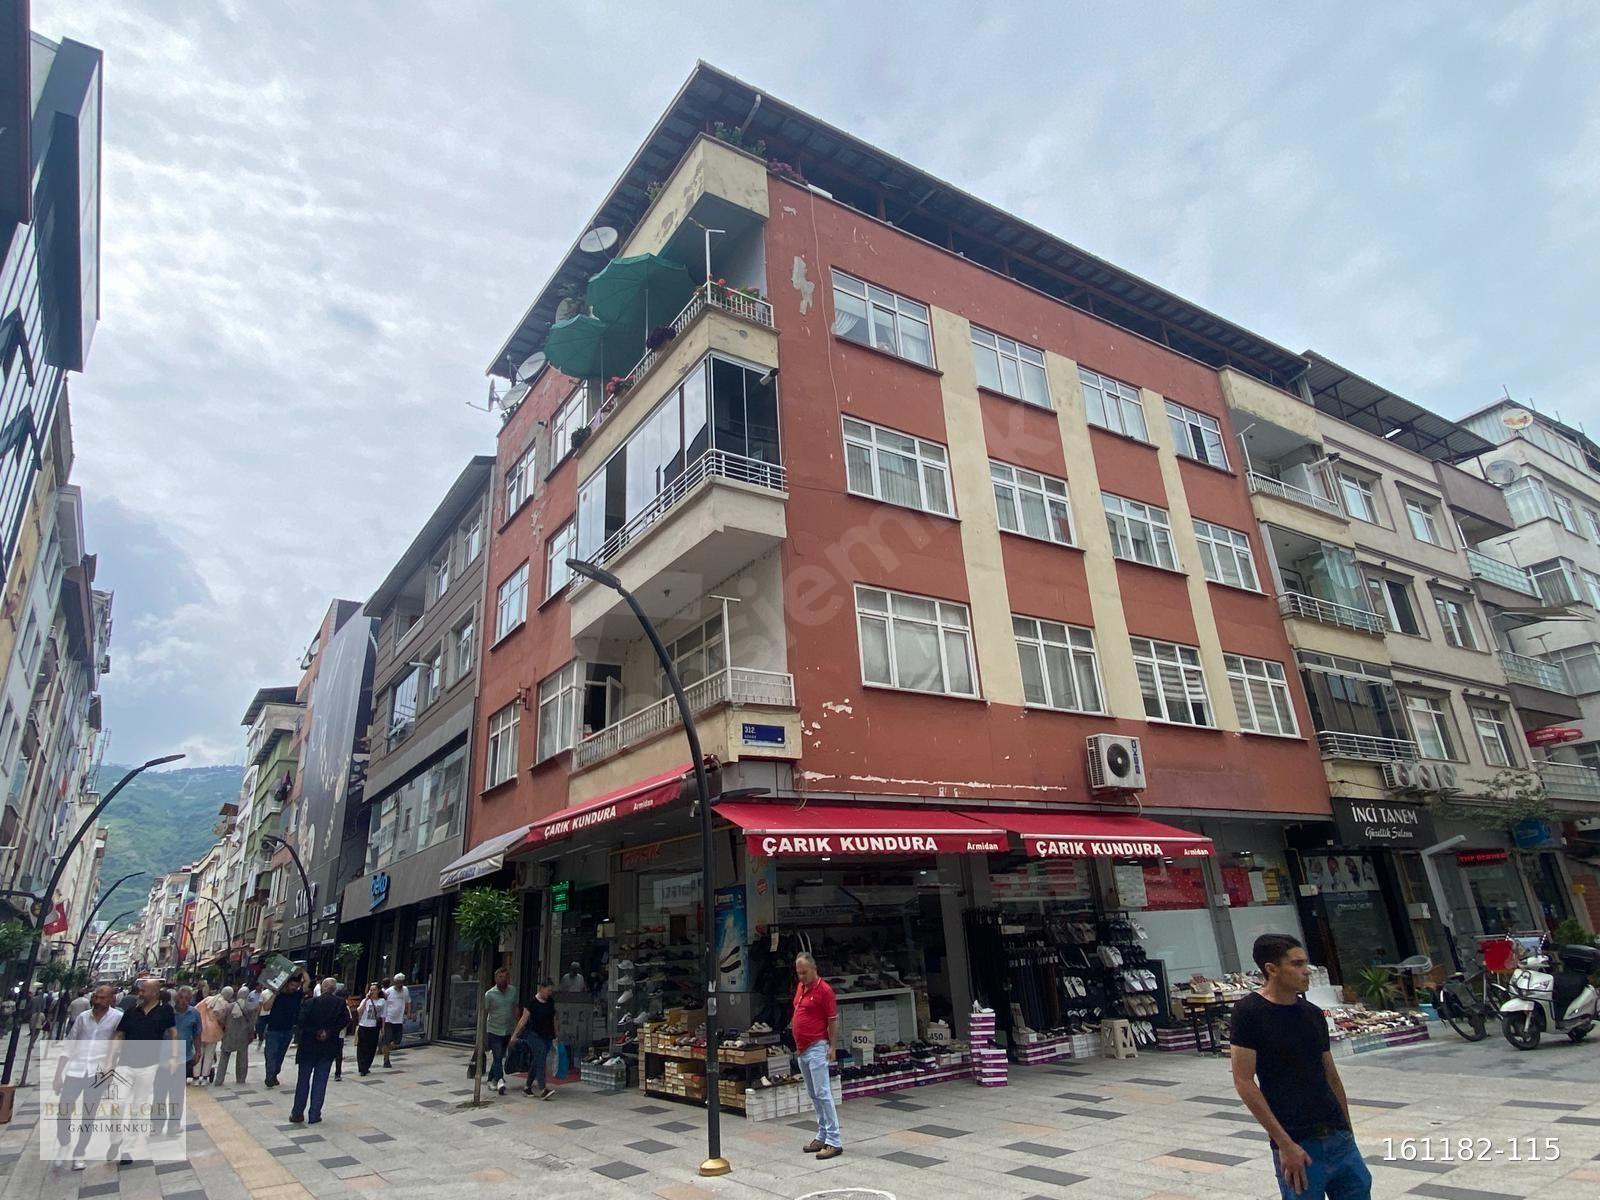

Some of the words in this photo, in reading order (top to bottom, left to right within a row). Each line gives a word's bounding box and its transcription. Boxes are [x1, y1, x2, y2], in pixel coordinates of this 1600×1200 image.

[1131, 739, 1141, 774] BEKO
[633, 799, 654, 811] Armidan
[1350, 802, 1378, 823] İNCİ
[1378, 807, 1418, 825] TANEM
[544, 820, 569, 839] ÇARIK
[572, 805, 617, 830] KUNDURA
[762, 837, 832, 856] ÇARIK
[840, 836, 938, 852] KUNDURA
[966, 841, 999, 851] Armidan
[1035, 840, 1087, 858] ÇARIK
[1090, 842, 1164, 856] KUNDURA
[852, 1035, 868, 1044] 450
[929, 1032, 944, 1041] 450
